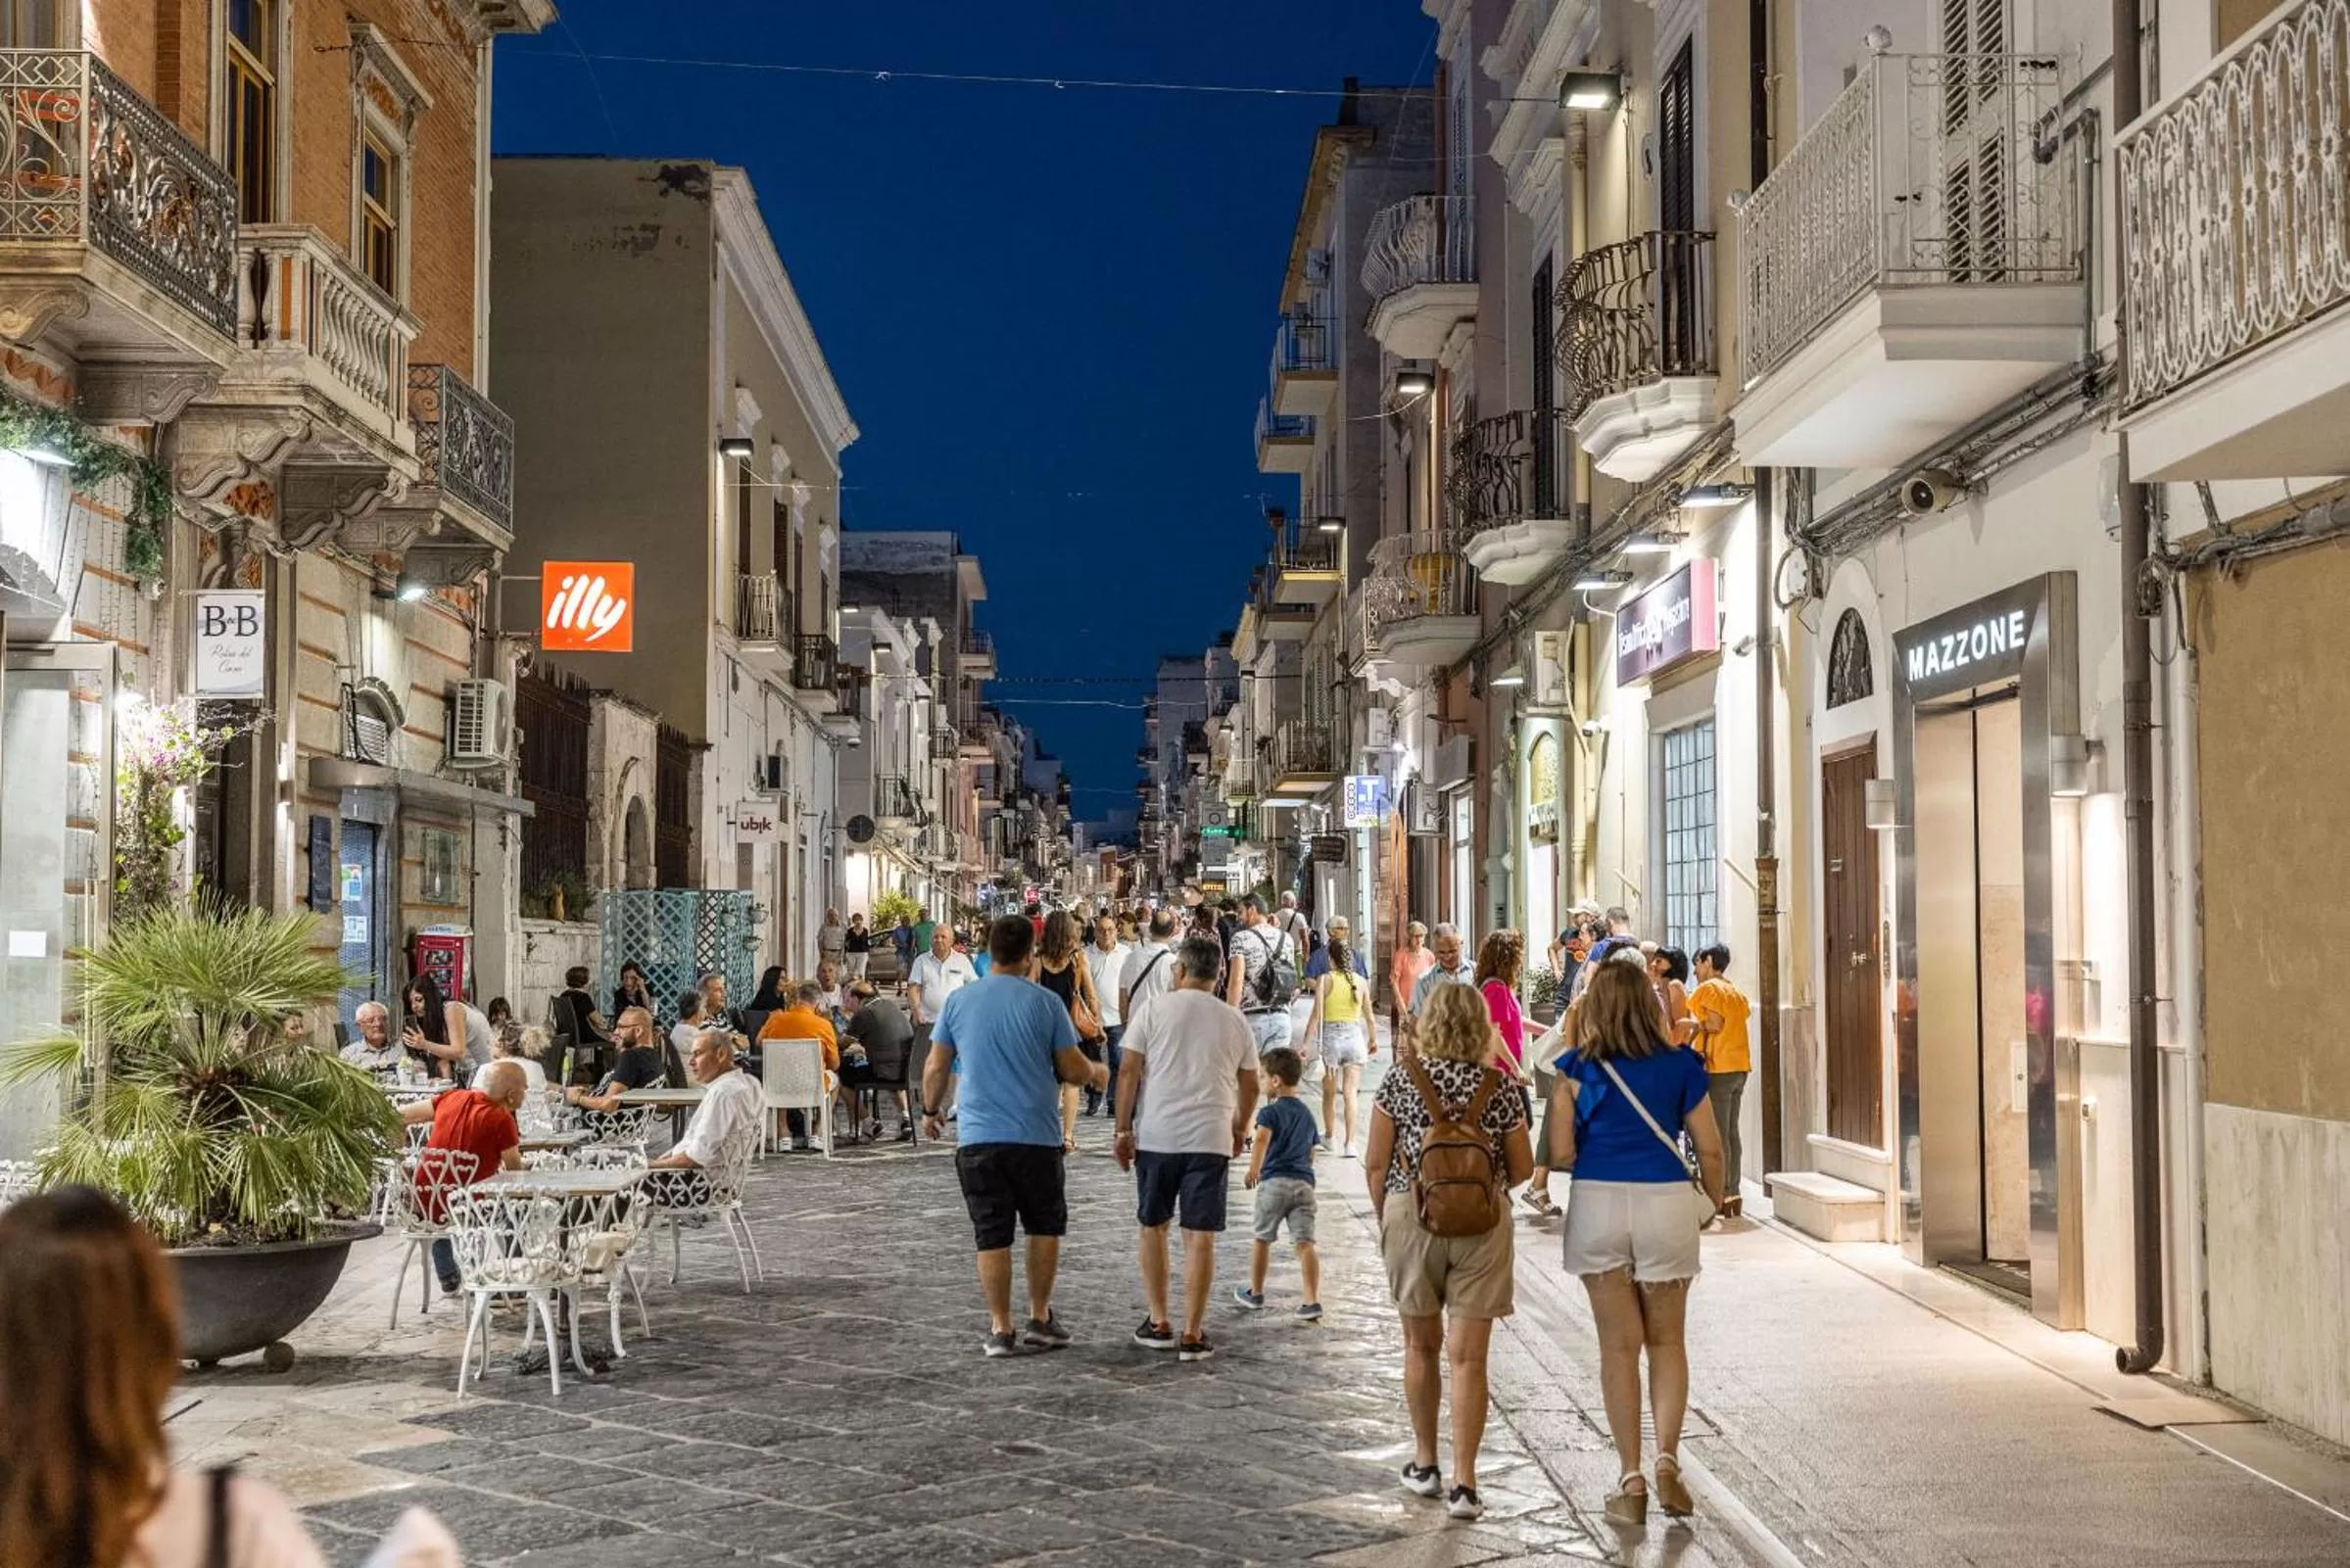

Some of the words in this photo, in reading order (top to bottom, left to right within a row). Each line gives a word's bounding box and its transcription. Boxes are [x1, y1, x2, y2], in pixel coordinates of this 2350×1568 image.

[547, 574, 627, 642] illy
[1908, 609, 2025, 682] MAZZONE
[741, 816, 772, 834] ubik
